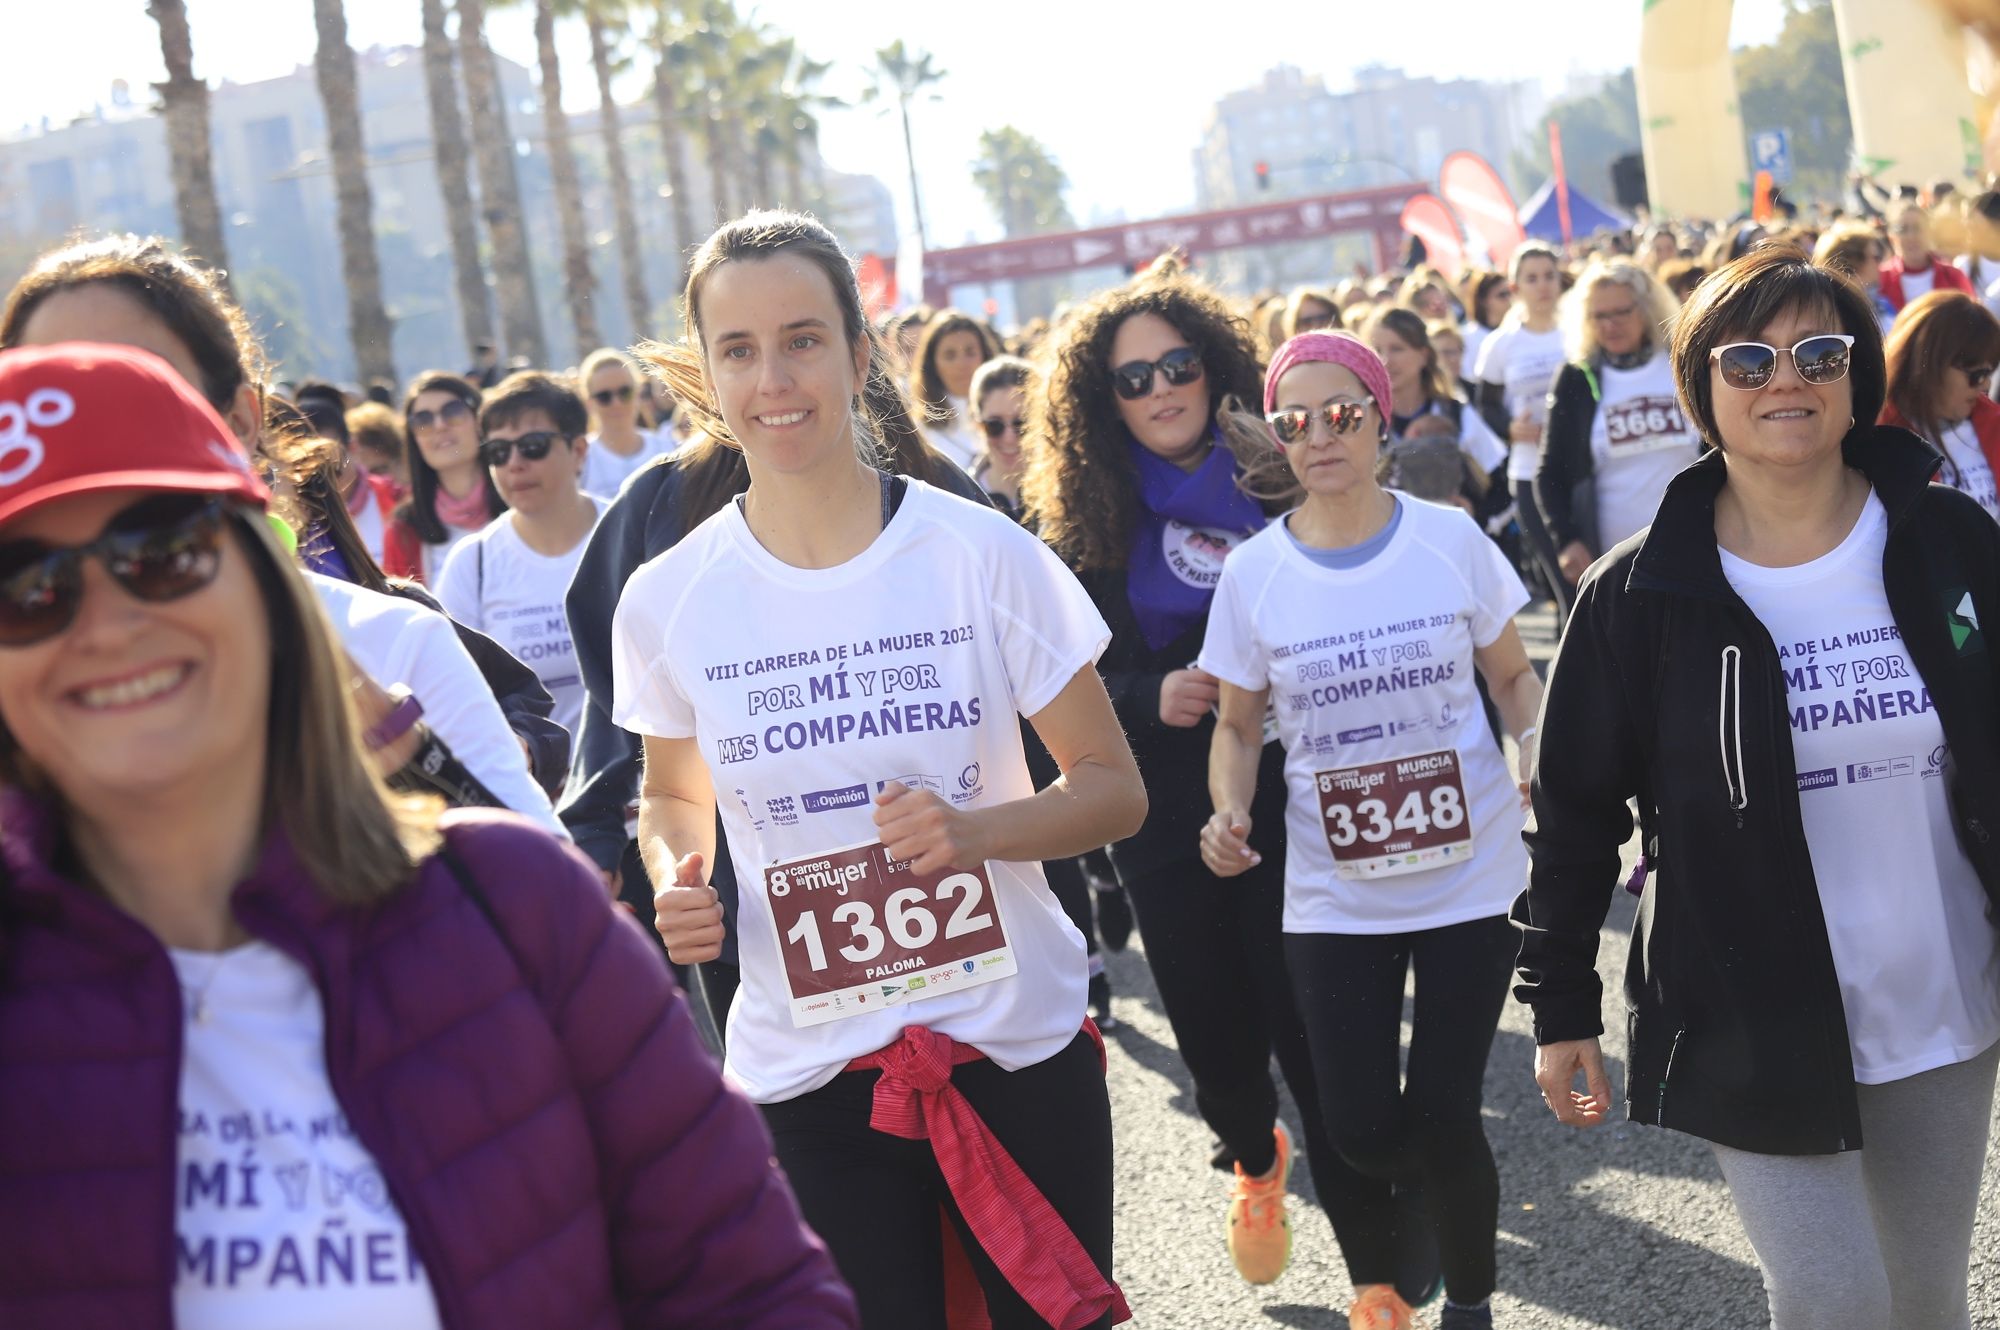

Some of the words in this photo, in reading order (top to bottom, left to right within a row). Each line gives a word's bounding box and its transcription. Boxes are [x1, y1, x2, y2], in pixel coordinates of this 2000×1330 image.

[1608, 408, 1683, 440] 3661
[1173, 557, 1188, 573] DE
[1293, 635, 1346, 654] CARRERA
[1350, 631, 1365, 644] DE
[1369, 627, 1384, 640] LA
[1387, 618, 1426, 636] MUJER
[1429, 613, 1456, 627] 2023
[1794, 640, 1817, 657] DE
[1821, 636, 1843, 652] LA
[1846, 625, 1901, 647] MUJER
[705, 663, 739, 682] VIII
[744, 650, 821, 676] CARRERA
[826, 645, 848, 662] DE
[853, 640, 874, 657] LA
[879, 632, 936, 653] MUJER
[940, 625, 974, 646] 2023
[1297, 660, 1336, 683] POR
[1338, 644, 1369, 672] MÍ
[1371, 647, 1387, 666] Y
[1391, 640, 1432, 664] POR
[748, 684, 805, 716] POR
[808, 662, 851, 704] MÍ
[855, 670, 877, 697] Y
[882, 663, 941, 694] POR
[1312, 661, 1455, 708] COMPAÑERAS
[1782, 657, 1823, 694] MÍ
[1826, 663, 1847, 688] Y
[1852, 655, 1910, 684] POR
[718, 734, 758, 765] MIS
[764, 697, 981, 754] COMPAÑERAS
[1396, 754, 1453, 775] MURCIA
[1340, 772, 1386, 796] mujer
[772, 813, 797, 821] Murcia
[1326, 785, 1464, 847] 3348
[1384, 841, 1412, 854] TRINI
[790, 860, 831, 877] carrera
[805, 861, 868, 896] mujer
[888, 865, 895, 873] 5
[896, 861, 910, 871] DE
[787, 872, 994, 972] 1362
[865, 956, 926, 979] PALOMA
[184, 1149, 260, 1209] MÍ
